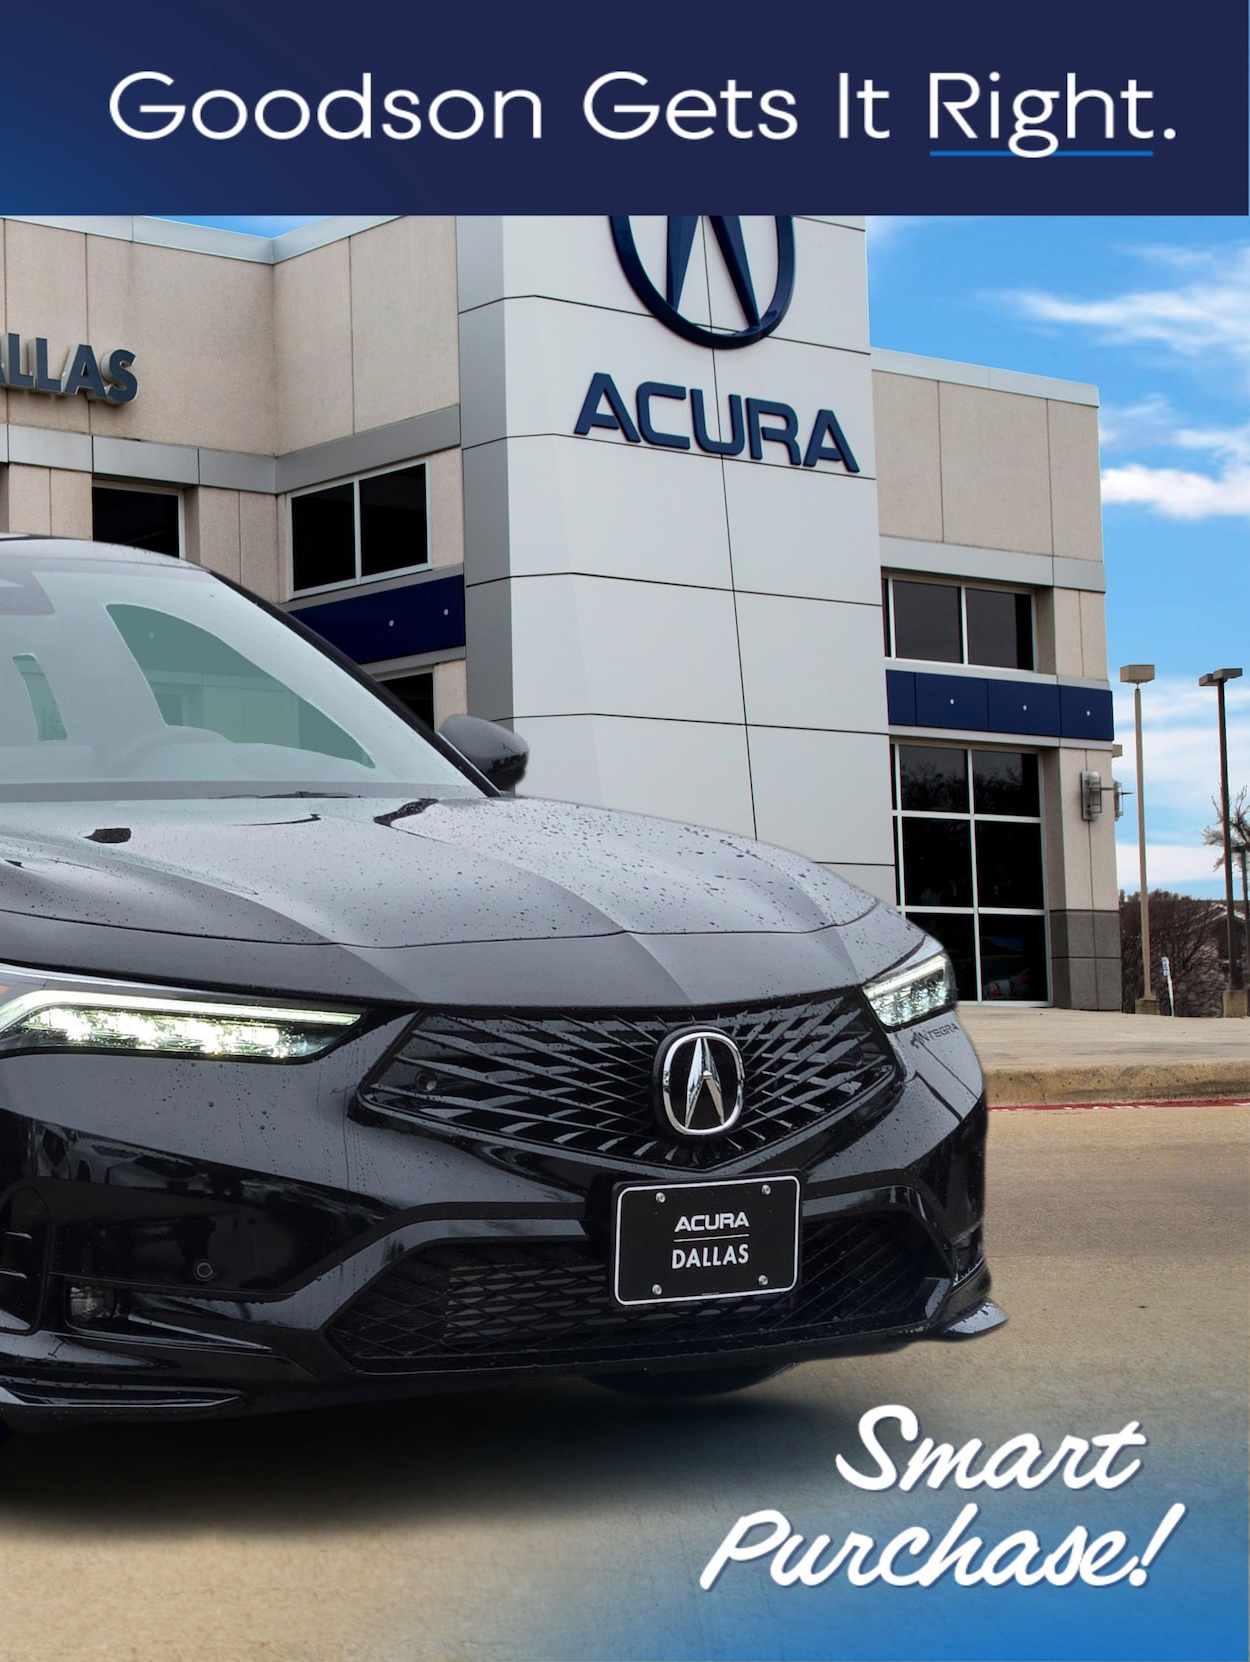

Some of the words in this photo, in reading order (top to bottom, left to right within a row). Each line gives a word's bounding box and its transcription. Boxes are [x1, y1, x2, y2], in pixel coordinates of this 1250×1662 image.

[573, 371, 861, 473] ACURA
[674, 1211, 750, 1233] ACURA
[671, 1243, 749, 1270] DALLAS
